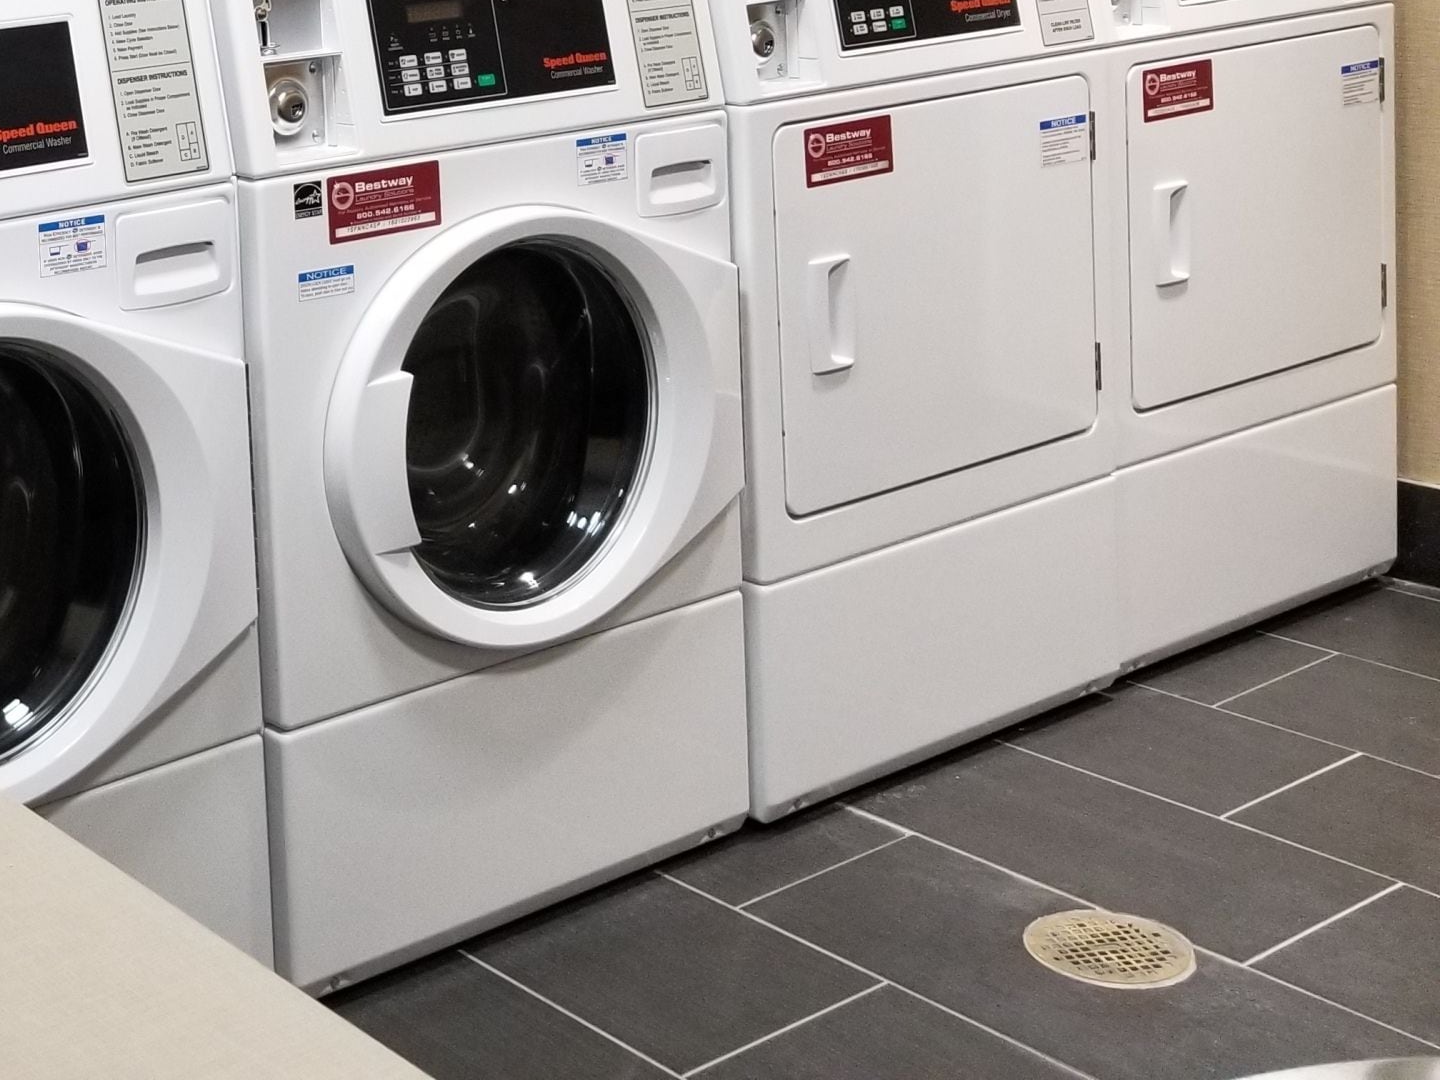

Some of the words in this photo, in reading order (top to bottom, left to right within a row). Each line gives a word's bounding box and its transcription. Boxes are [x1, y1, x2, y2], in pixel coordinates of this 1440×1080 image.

[659, 12, 690, 20] INSTRUCTIONS
[996, 9, 1011, 19] Dryer
[543, 54, 575, 69] Speed
[575, 52, 607, 63] Queen
[117, 75, 147, 85] DISPENSER
[149, 70, 187, 80] INSTRUCTIONS
[551, 69, 582, 79] Commercial
[583, 65, 604, 75] Washer
[1160, 70, 1196, 83] Bestway
[36, 120, 77, 134] Queen
[1051, 117, 1076, 127] NOTICE
[826, 128, 871, 143] Bestway
[2, 140, 45, 154] Commercial
[46, 136, 72, 148] Washer
[355, 176, 414, 193] Bestway
[356, 193, 382, 203] Laundry
[384, 188, 414, 198] Solutions
[59, 218, 86, 229] NOTICE
[306, 268, 347, 280] NOTICE
